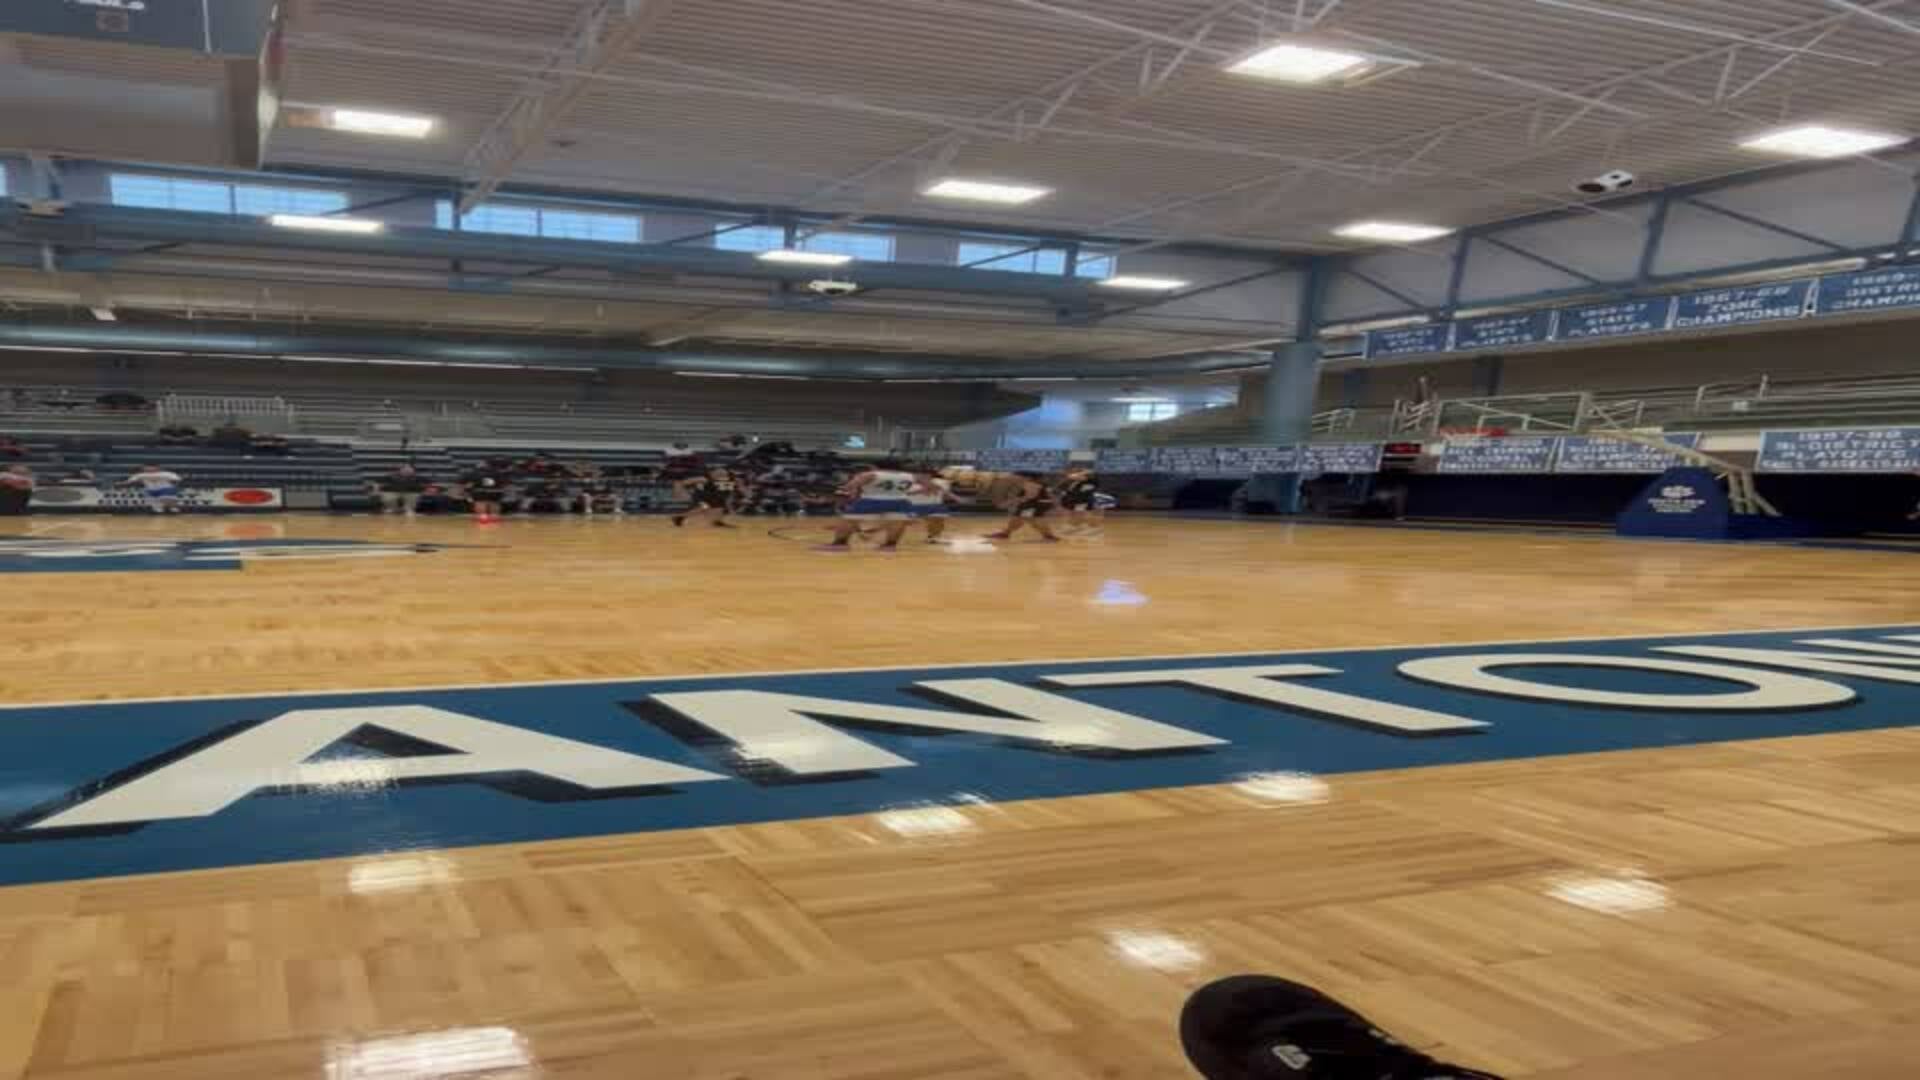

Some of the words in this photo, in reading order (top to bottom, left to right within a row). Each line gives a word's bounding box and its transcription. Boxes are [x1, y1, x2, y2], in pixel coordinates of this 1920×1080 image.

[1845, 283, 1920, 298] DISTRI
[1676, 306, 1800, 327] CHAMPIONS
[1780, 449, 1906, 460] PLAYOFFS
